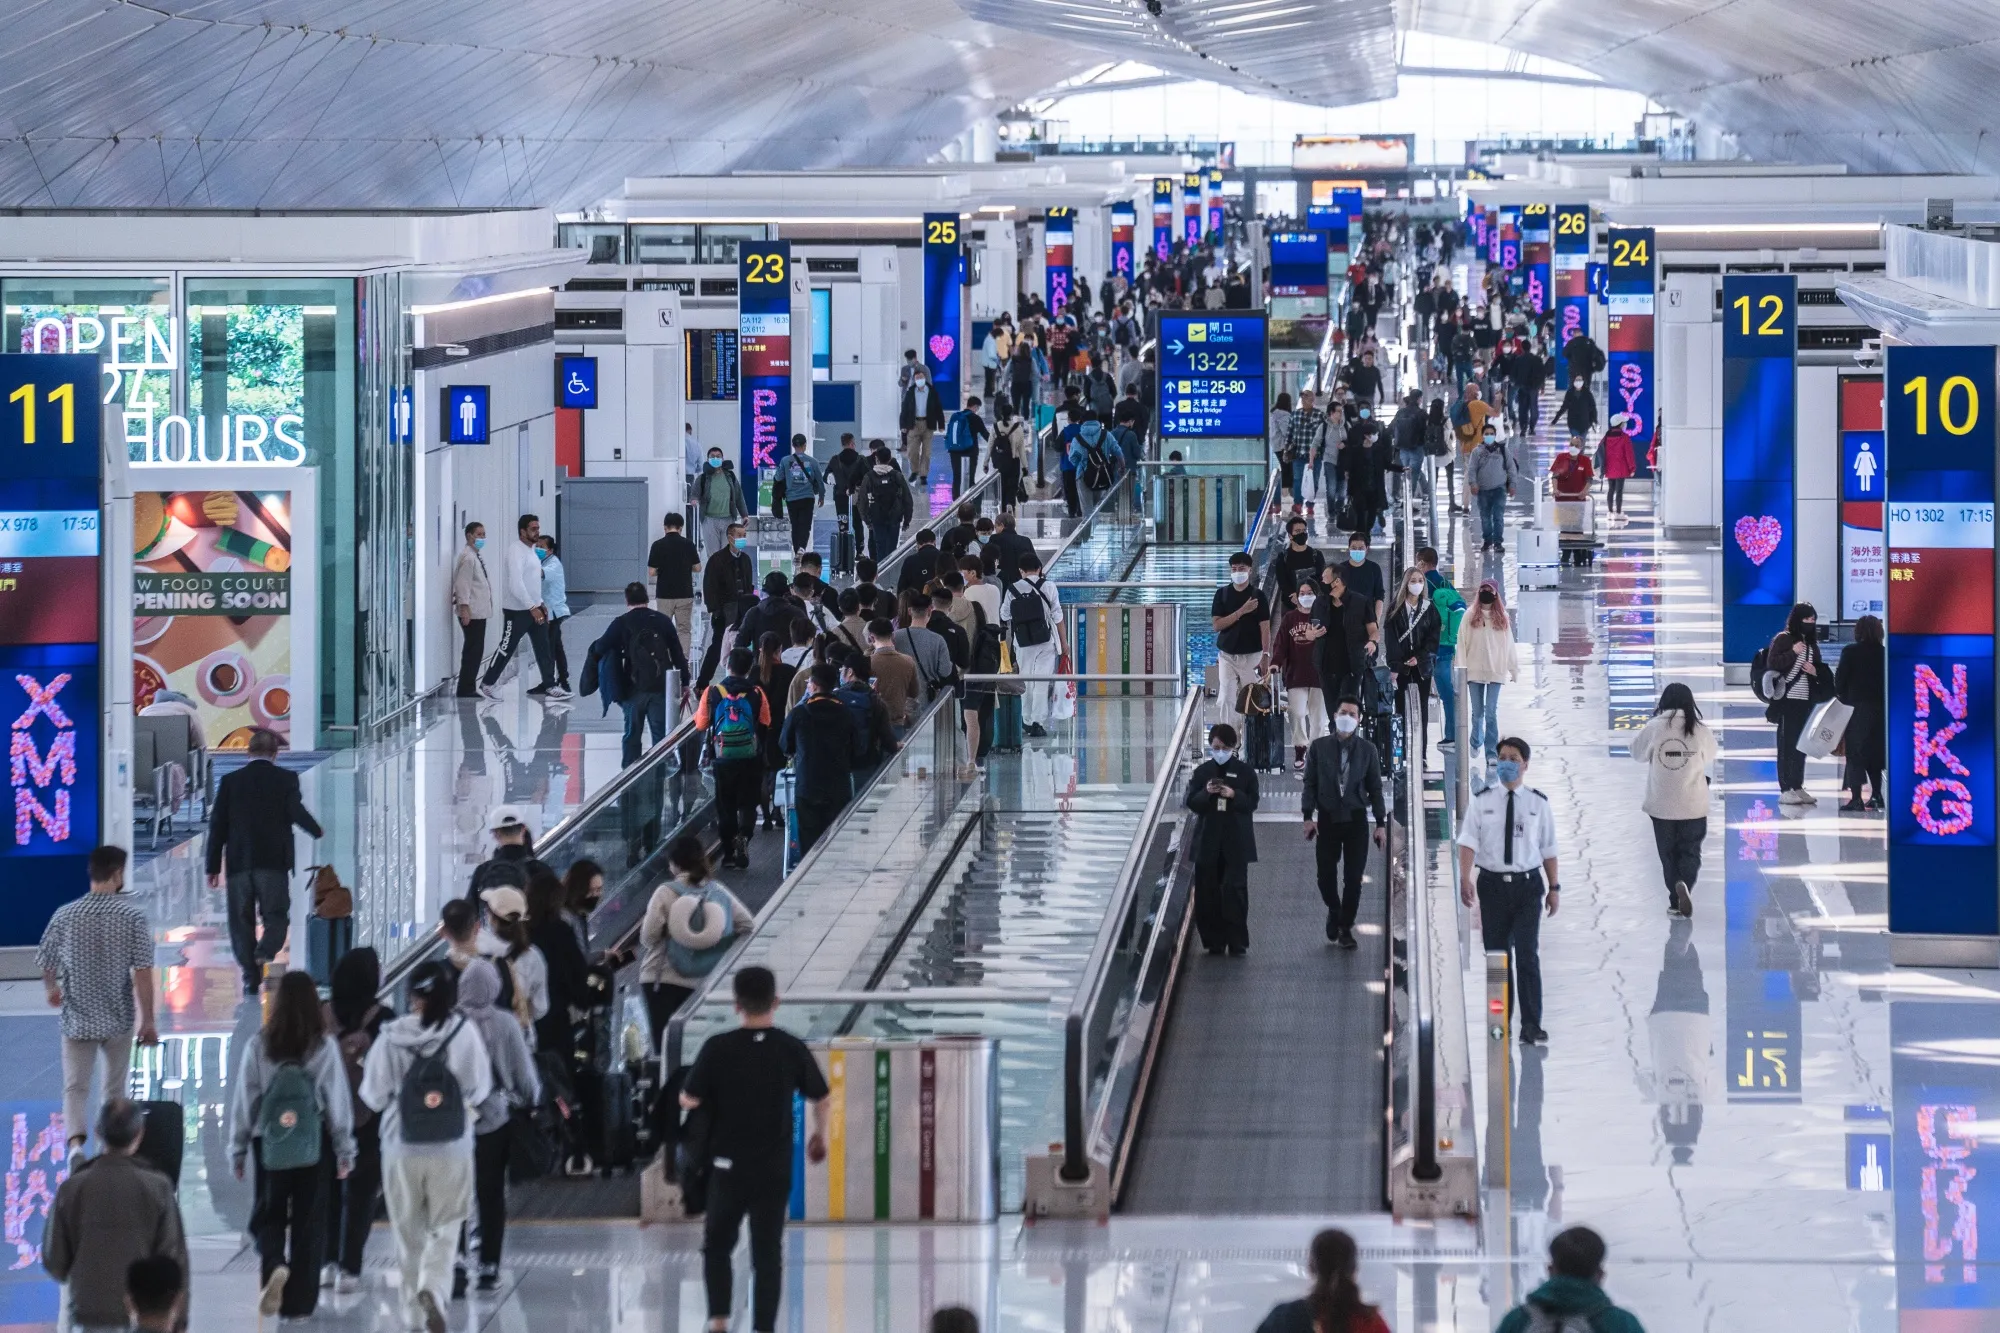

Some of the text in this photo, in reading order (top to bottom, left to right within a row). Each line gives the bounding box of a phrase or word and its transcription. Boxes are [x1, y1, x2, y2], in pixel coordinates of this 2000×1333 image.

[1156, 180, 1171, 194] 31
[928, 221, 956, 244] 25
[1558, 212, 1586, 234] 26
[1613, 239, 1649, 267] 24
[746, 254, 784, 283] 23
[1733, 295, 1784, 335] 12
[33, 316, 178, 369] OPEN
[1209, 334, 1233, 343] Gates
[1188, 352, 1238, 371] 13-22
[1210, 380, 1246, 394] 25-80
[1619, 363, 1643, 437] SYD
[1903, 375, 1979, 436] 10
[9, 383, 75, 444] 11
[121, 412, 306, 468] HOURS
[752, 389, 778, 470] PEK
[0, 517, 96, 531] X 978 17:50
[1891, 509, 1993, 523] HO 1302 17:15
[0, 562, 23, 573] 港至
[1890, 552, 1921, 564] 香港至
[0, 578, 17, 591] 門
[161, 579, 213, 591] FOOD
[221, 578, 287, 591] COURT
[1890, 568, 1915, 581] 南京
[133, 591, 287, 610] PENING SOON
[501, 620, 513, 651] adidas
[10, 673, 77, 845] XMN
[1911, 663, 1974, 836] NKG
